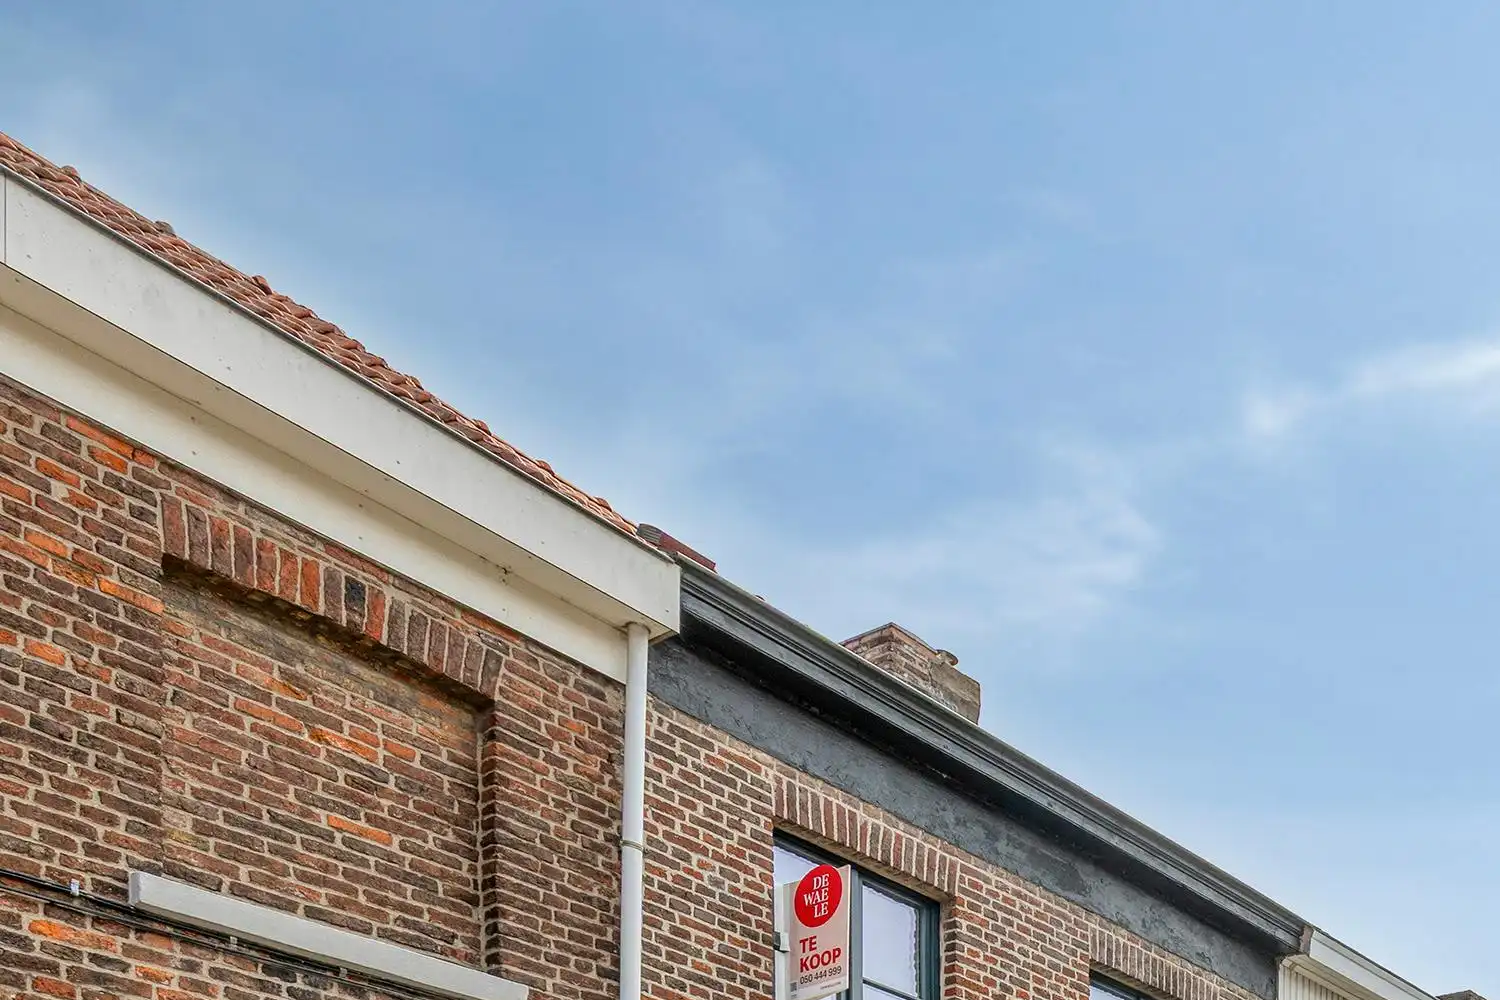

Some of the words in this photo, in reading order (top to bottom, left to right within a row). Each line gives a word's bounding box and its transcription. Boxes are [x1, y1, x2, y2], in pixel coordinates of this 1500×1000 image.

[813, 873, 830, 889] DE
[803, 886, 829, 907] WAE
[813, 902, 829, 918] LE
[799, 935, 817, 954] TE
[799, 947, 842, 973] KOOP
[799, 974, 813, 985] 050
[814, 969, 827, 980] 444
[828, 965, 842, 977] 999
